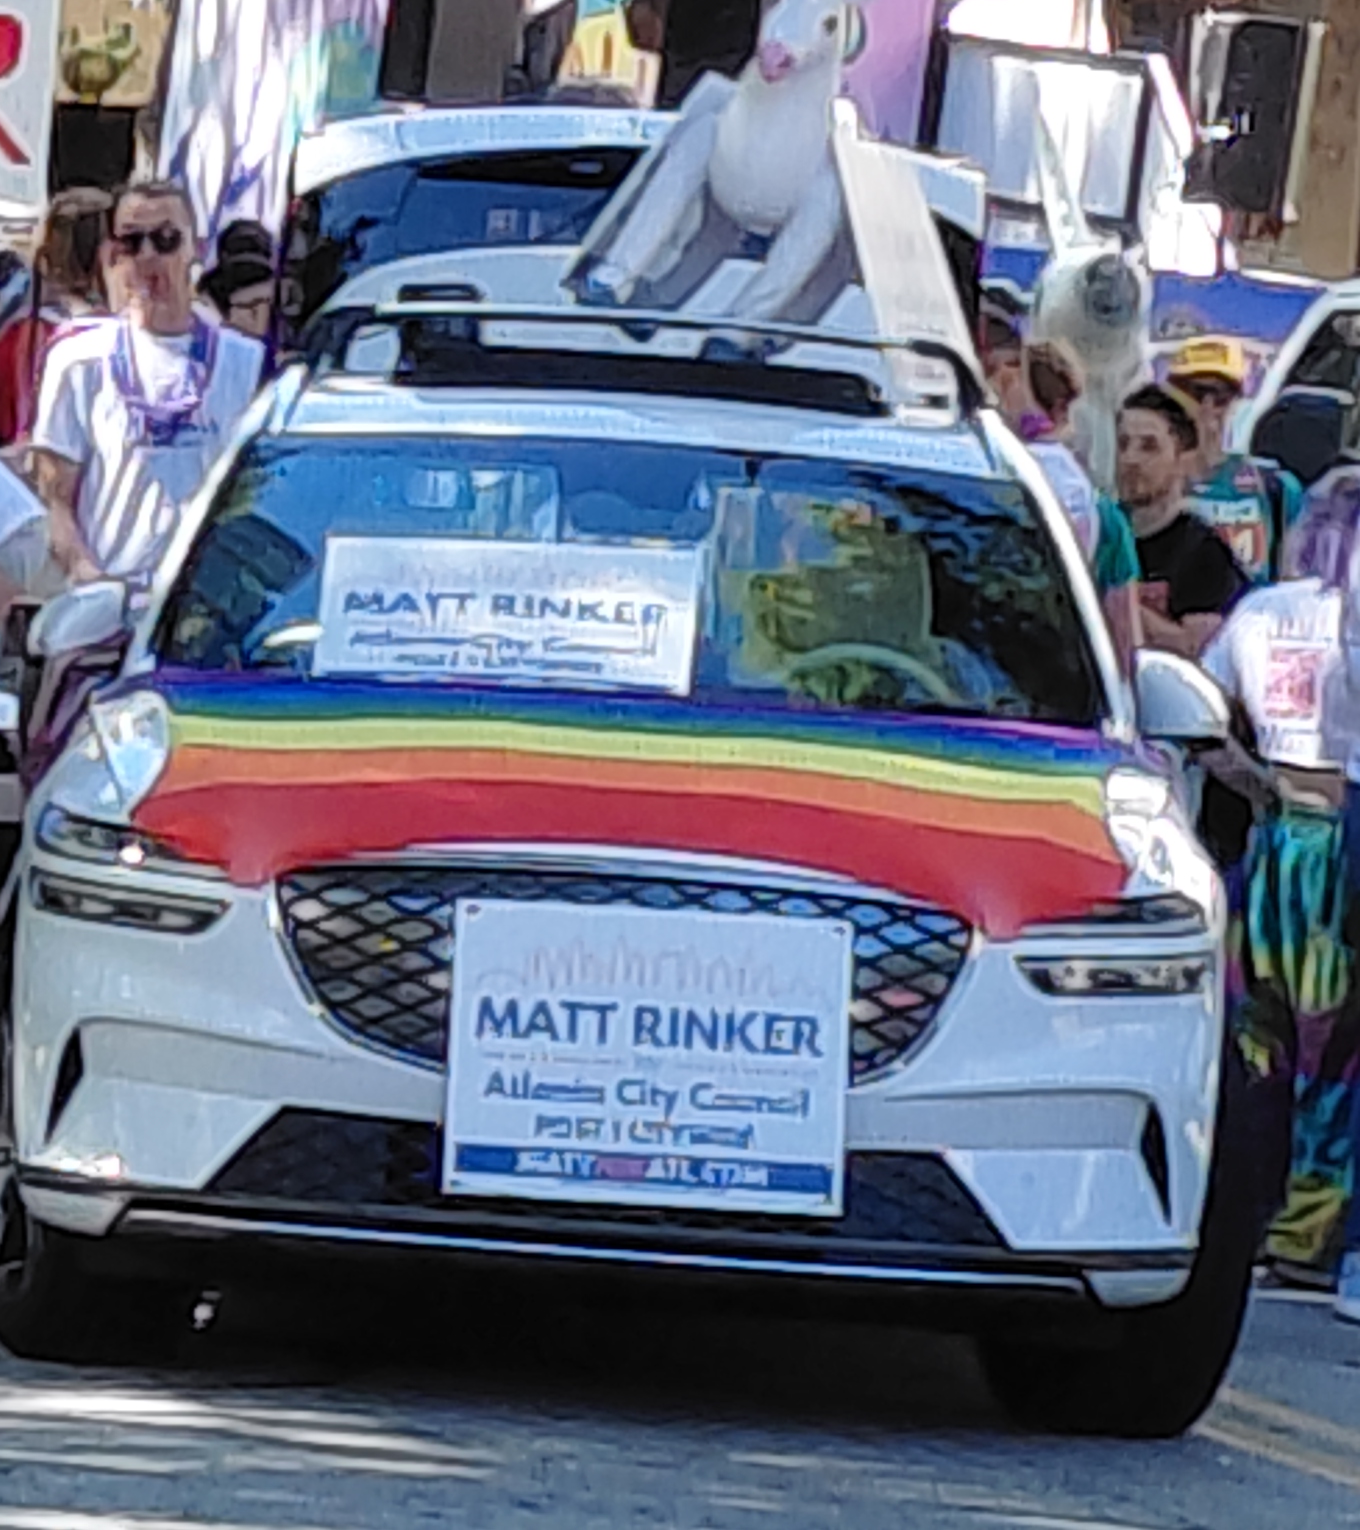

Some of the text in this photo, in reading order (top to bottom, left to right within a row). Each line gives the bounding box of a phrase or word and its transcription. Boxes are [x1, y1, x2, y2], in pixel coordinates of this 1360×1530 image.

[342, 589, 670, 628] MATT RINKER
[475, 994, 824, 1058] MATT RINKER
